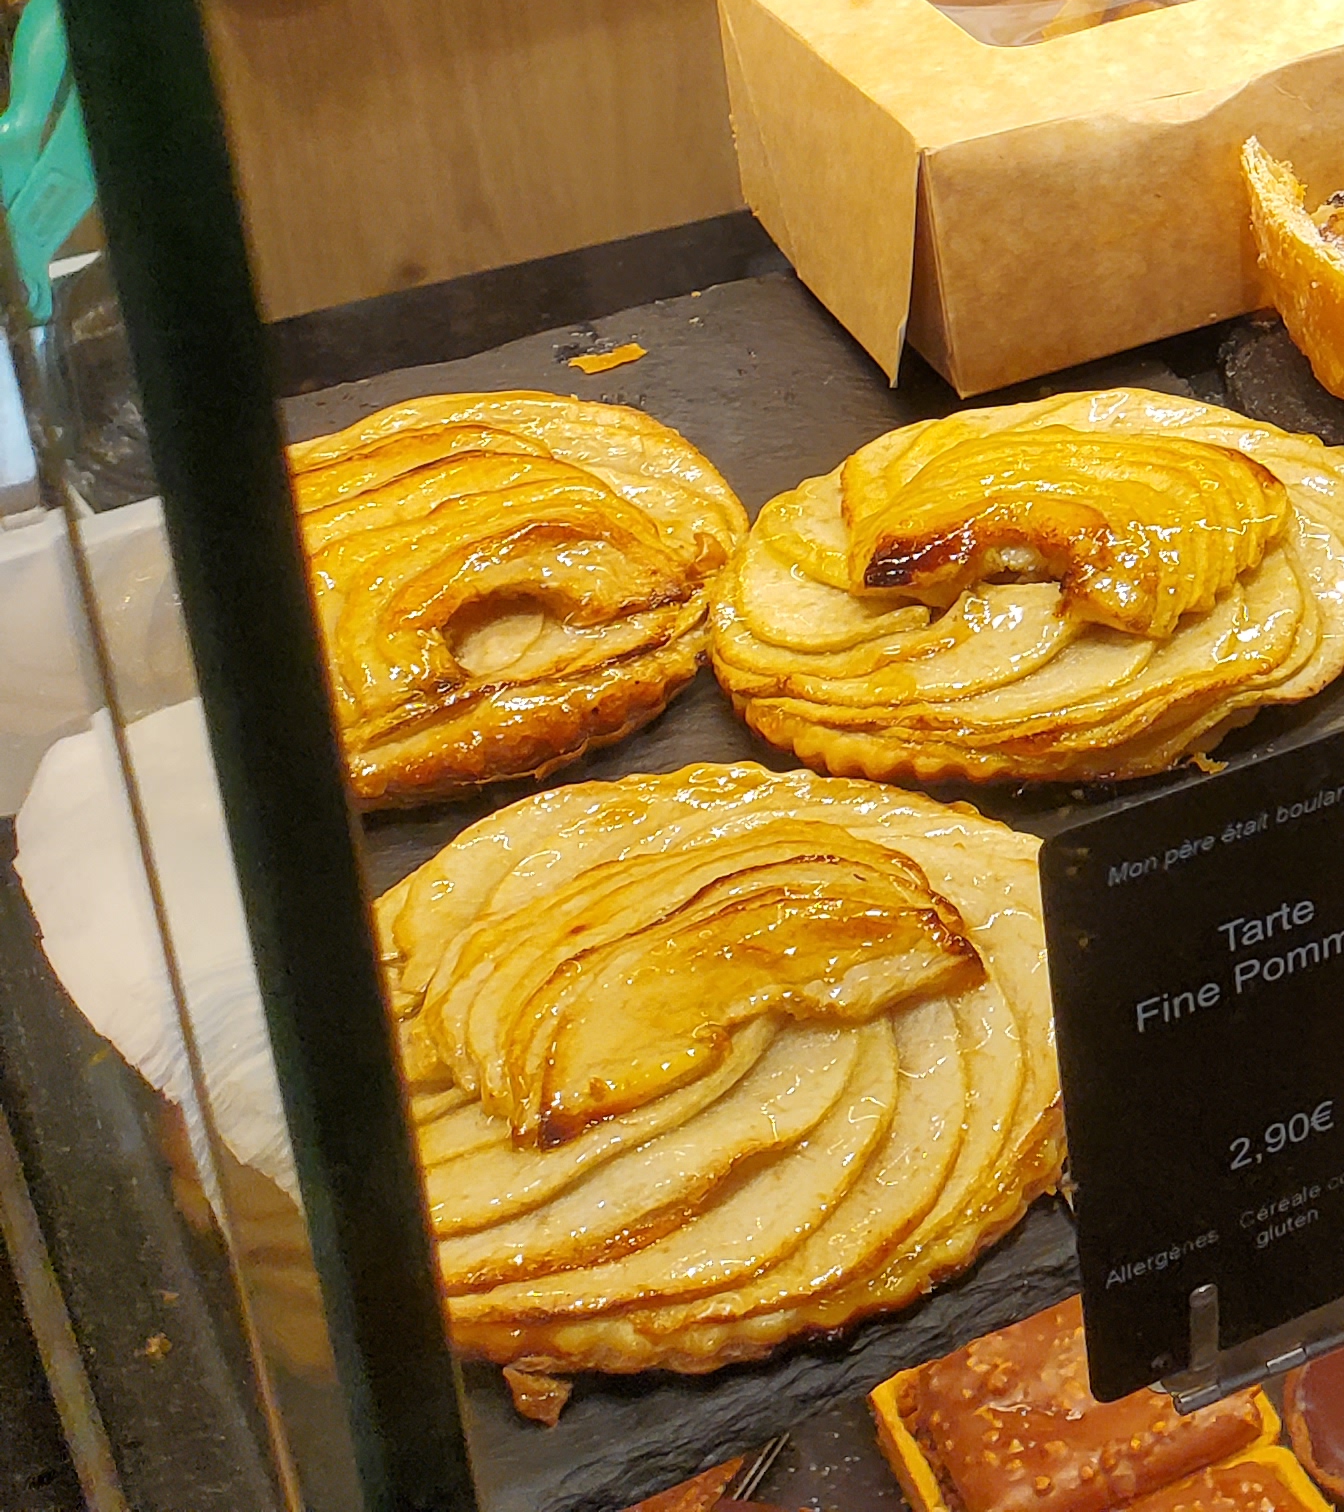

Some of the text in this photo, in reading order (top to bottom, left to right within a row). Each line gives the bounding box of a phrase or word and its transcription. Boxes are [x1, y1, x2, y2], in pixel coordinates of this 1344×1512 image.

[1107, 855, 1157, 887] Mon
[1163, 834, 1215, 870] père
[1221, 811, 1270, 842] était
[1218, 899, 1315, 952] Tarte
[1136, 982, 1221, 1033] Fine
[1229, 1100, 1334, 1171] 2,90€
[1255, 1207, 1320, 1249] gluten
[1105, 1228, 1220, 1289] Allergènes
